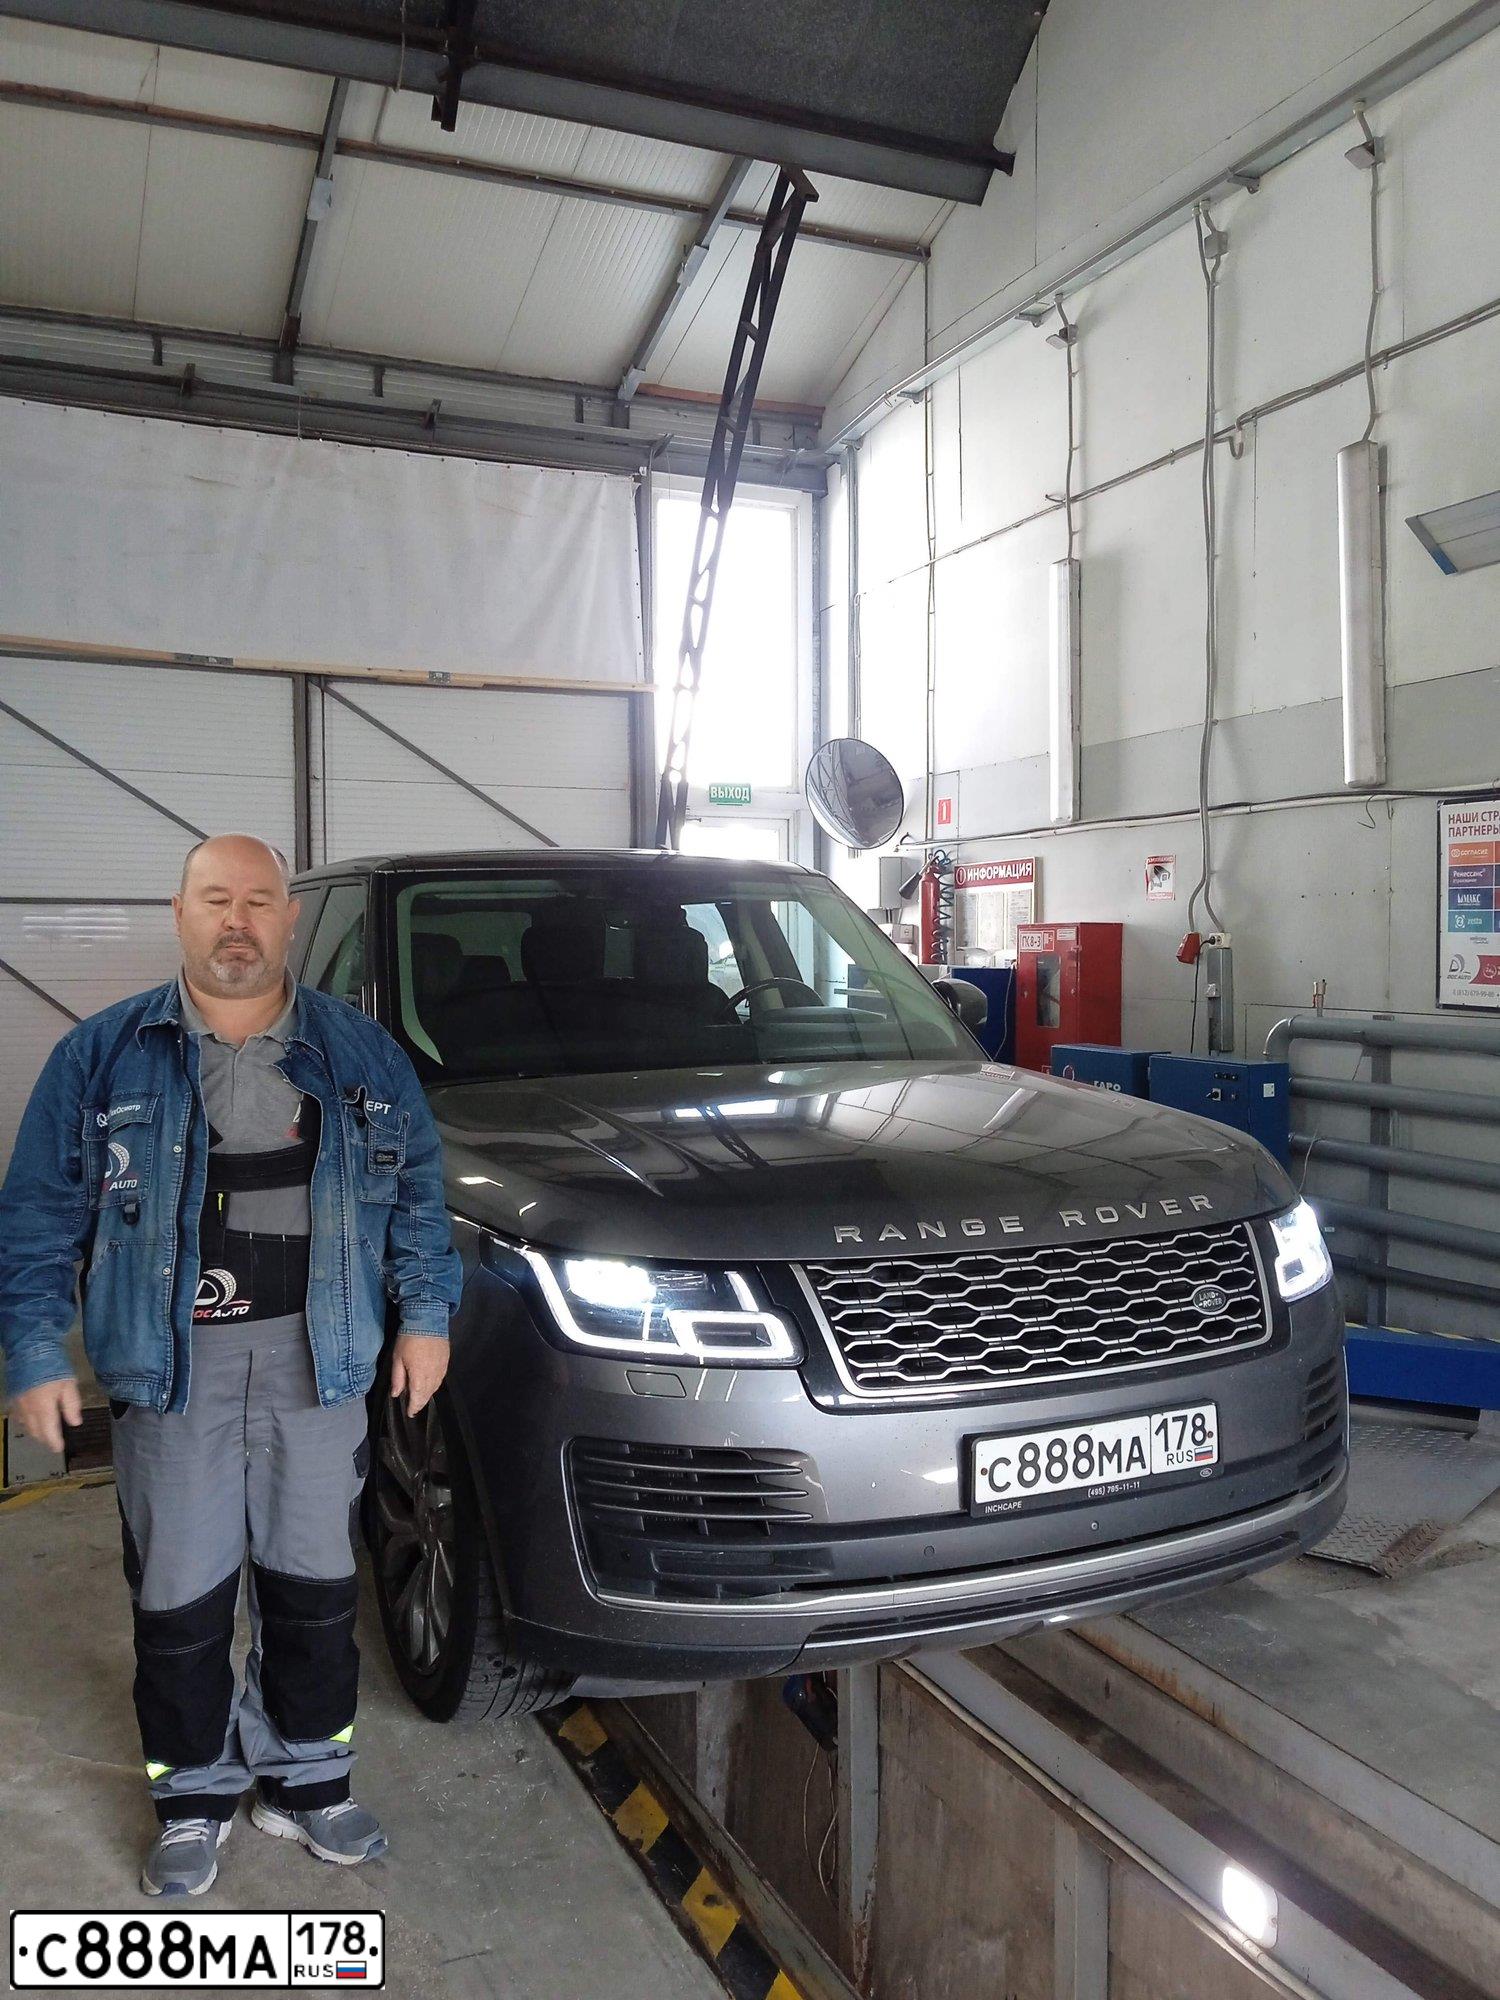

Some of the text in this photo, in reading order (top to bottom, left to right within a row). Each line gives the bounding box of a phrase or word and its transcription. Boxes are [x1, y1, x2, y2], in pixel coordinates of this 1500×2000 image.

[711, 786, 750, 801] ВЫХОД
[1448, 810, 1500, 824] НАШИ СТР
[967, 862, 1032, 882] ИНФОРМАЦИЯ
[833, 1194, 1214, 1243] RANGE ROVER
[192, 1305, 250, 1318] OCAUTO
[1154, 1412, 1207, 1452] 178
[1166, 1451, 1194, 1466] RUS
[1087, 1486, 1106, 1498] (495)
[985, 1501, 1022, 1514] INCHCAPE
